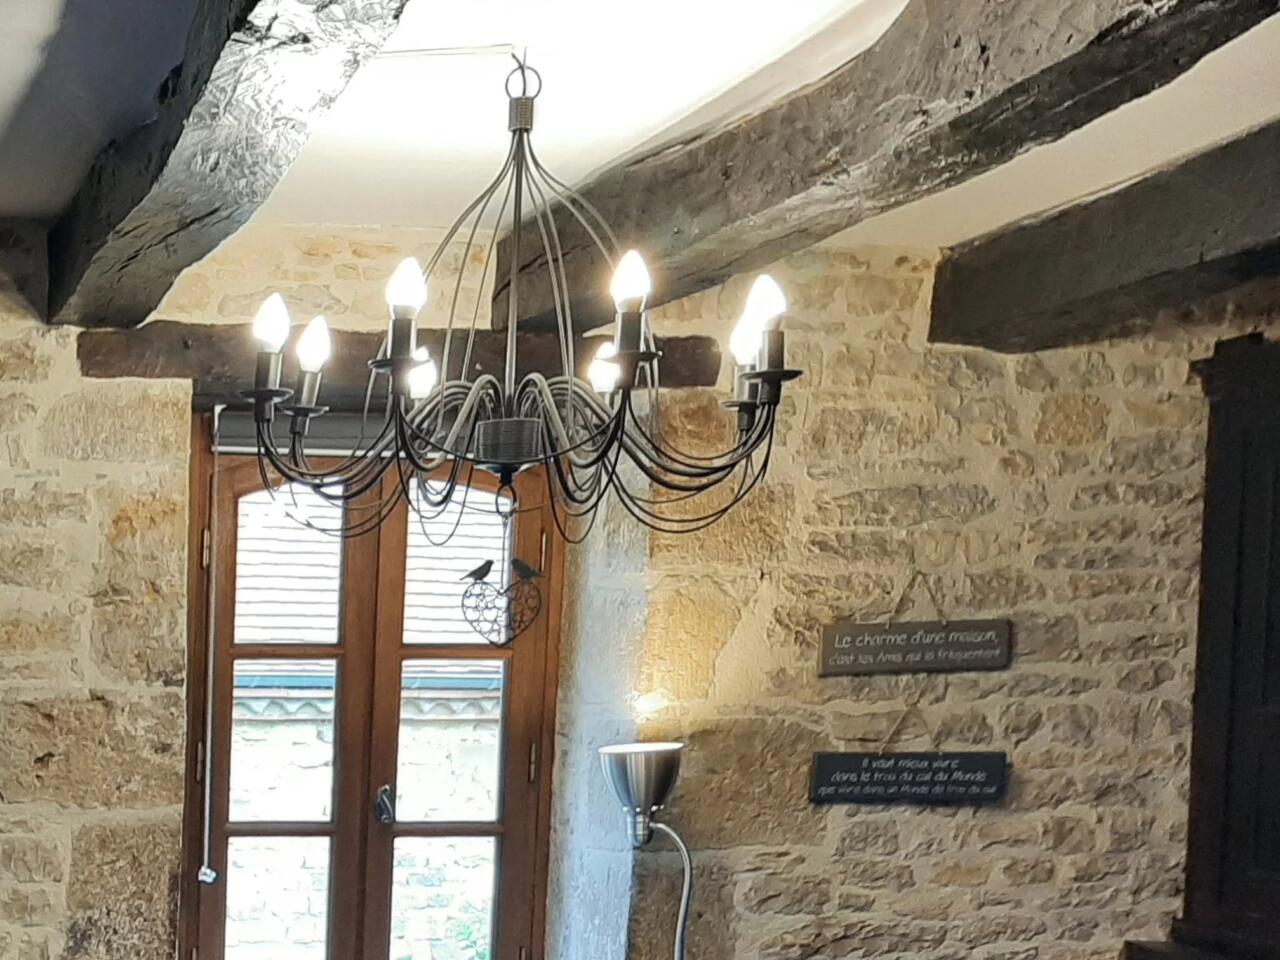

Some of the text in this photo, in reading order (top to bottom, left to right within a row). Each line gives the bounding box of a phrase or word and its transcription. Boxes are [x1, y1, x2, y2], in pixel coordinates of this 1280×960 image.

[834, 633, 851, 648] Le
[855, 631, 907, 647] charme
[910, 630, 946, 644] d'une
[905, 651, 921, 665] qui
